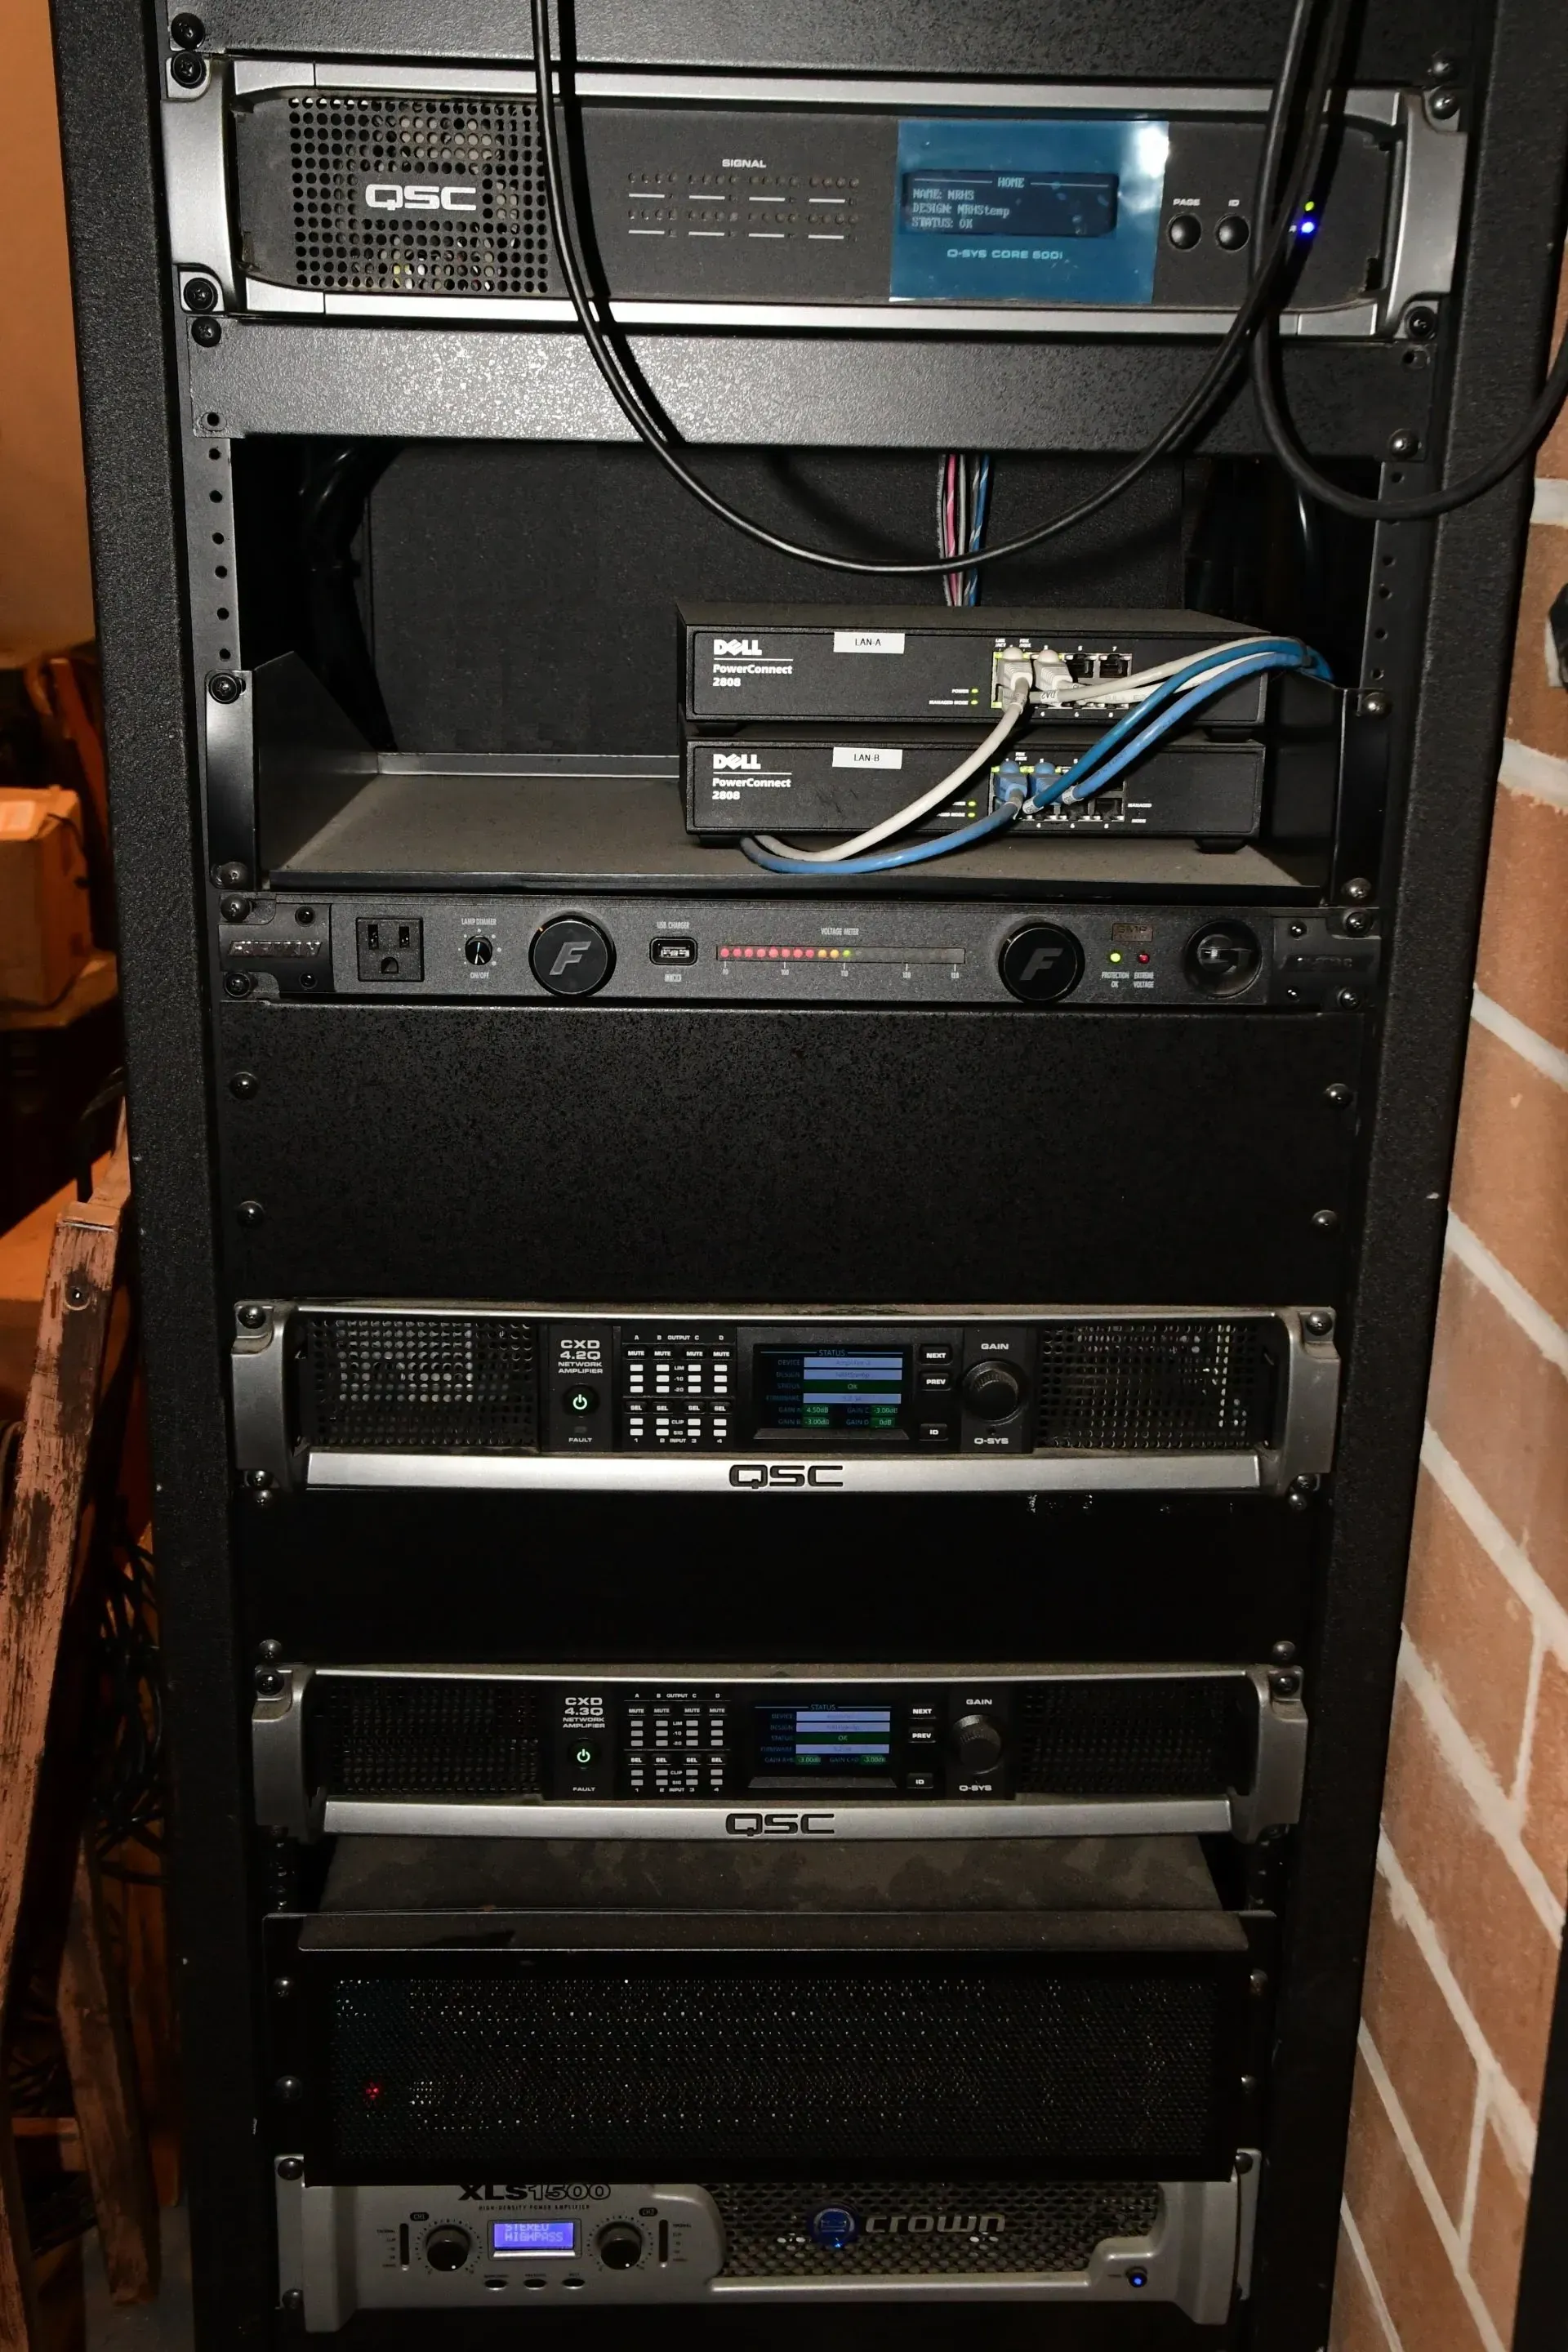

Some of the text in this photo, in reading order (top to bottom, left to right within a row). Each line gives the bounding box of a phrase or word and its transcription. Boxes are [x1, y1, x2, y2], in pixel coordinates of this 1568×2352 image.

[722, 159, 767, 168] SIGNAL
[998, 177, 1025, 189] HOME
[365, 183, 477, 212] QSC
[960, 219, 973, 229] OK
[947, 249, 987, 259] Q-SYS
[992, 250, 1028, 259] CORE
[714, 639, 762, 656] DELL
[855, 639, 881, 647] LAN-A
[713, 664, 793, 674] PowerConnect
[713, 678, 741, 687] 2808
[713, 754, 761, 770] DELL
[853, 754, 880, 762] LAN-B
[712, 778, 791, 788] PowerConnect
[712, 791, 740, 800] 2808
[668, 921, 690, 929] CHARGER
[844, 928, 859, 936] METER
[549, 941, 591, 975] F
[1019, 947, 1064, 981] F
[560, 1339, 600, 1349] CXD
[559, 1351, 601, 1361] 4.2Q
[729, 1464, 844, 1489] QSC
[565, 1697, 602, 1706] CXD
[564, 1707, 604, 1715] 4.3Q
[726, 1813, 835, 1837] QSC
[458, 2184, 611, 2200] XLS1500
[866, 2215, 1005, 2233] crown
[505, 2232, 564, 2242] HIGHPASS
